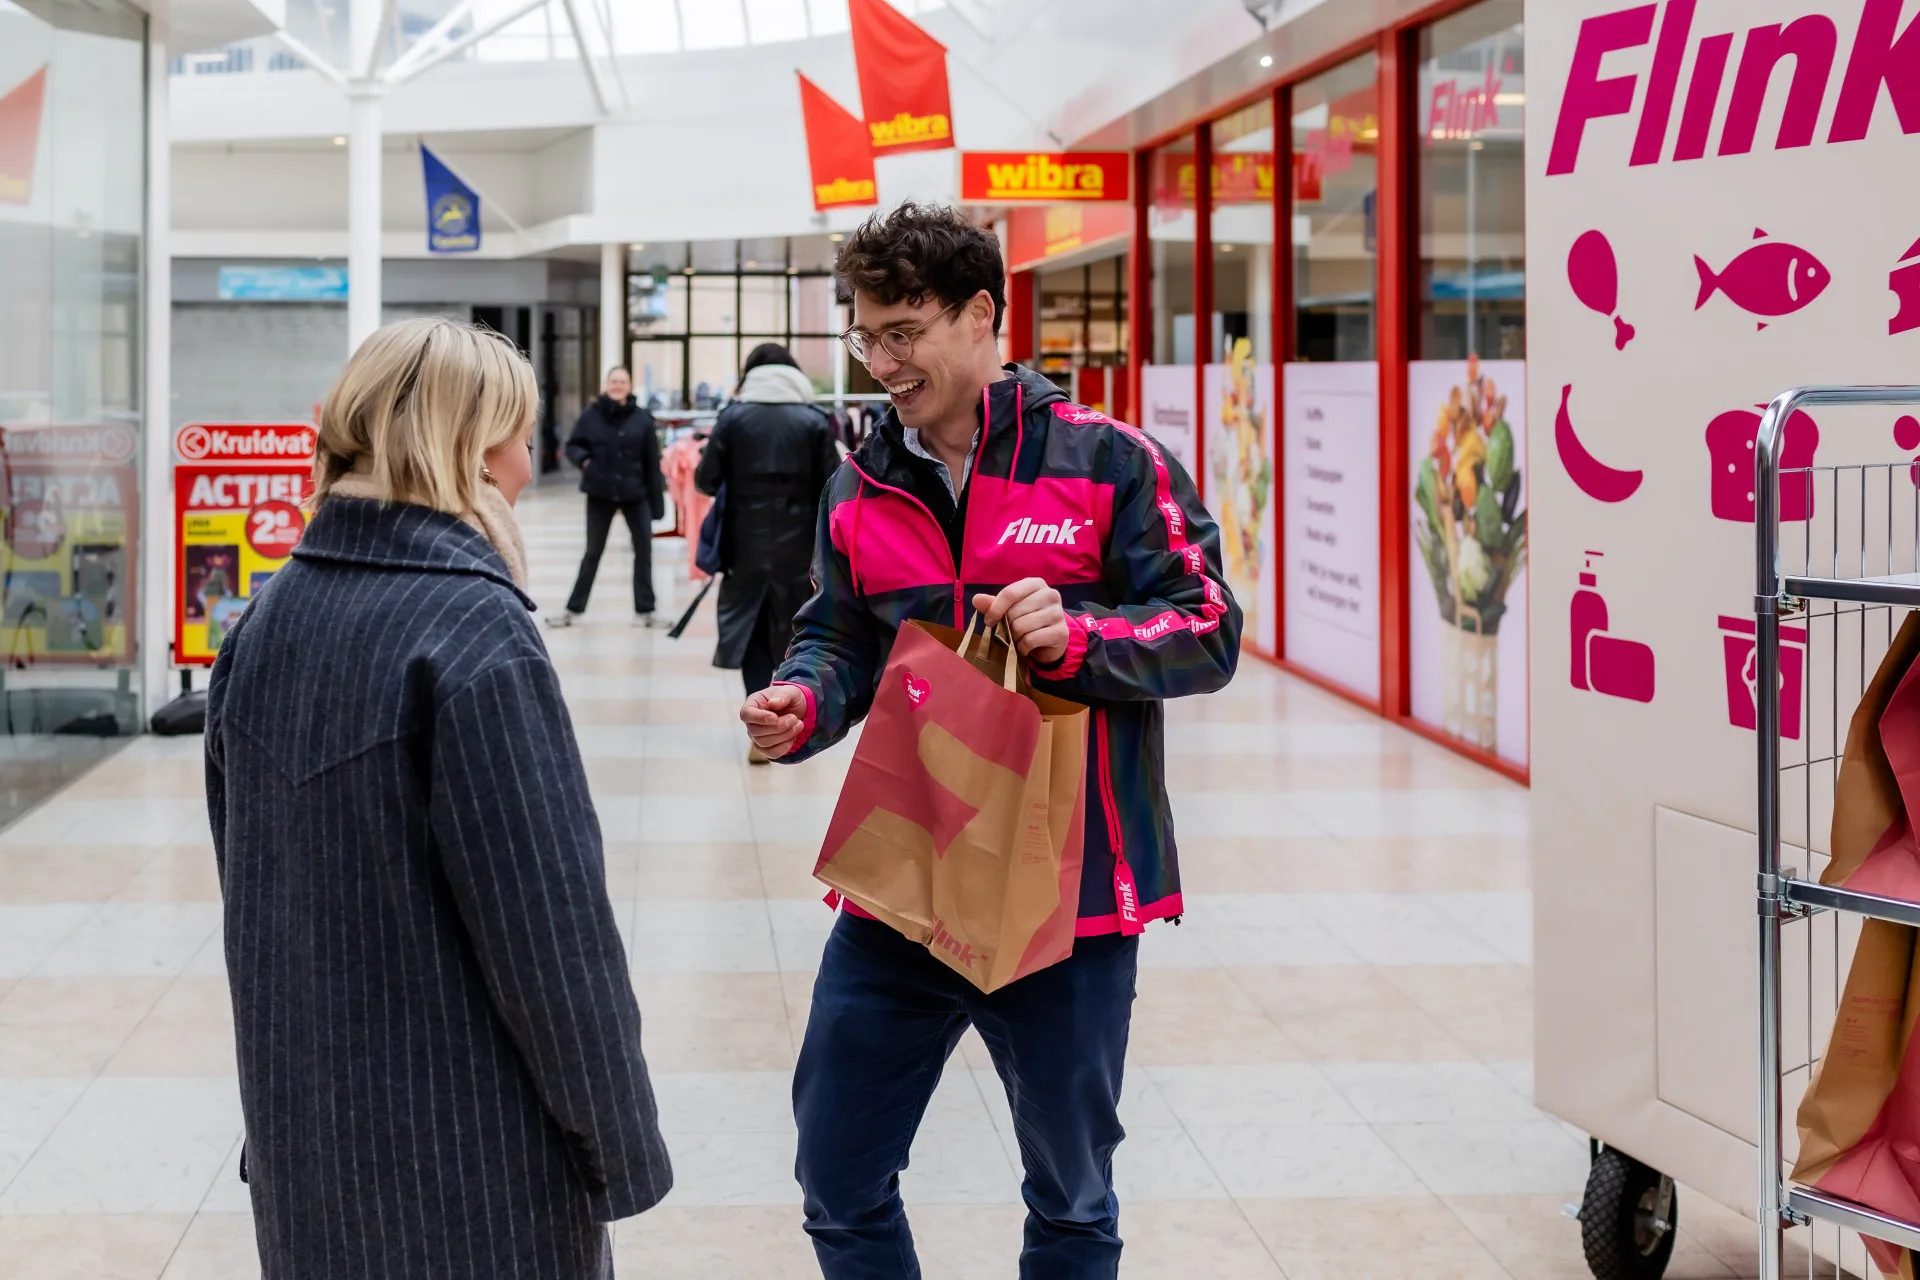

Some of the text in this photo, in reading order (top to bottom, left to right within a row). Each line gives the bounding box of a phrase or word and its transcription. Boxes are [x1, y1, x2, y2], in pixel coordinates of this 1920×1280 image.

[1546, 0, 1920, 177] Flink
[868, 112, 949, 142] wibra
[815, 177, 875, 201] wibra
[986, 155, 1104, 190] wibra
[211, 428, 313, 455] Kruidvat
[188, 474, 302, 507] ACTIE!
[997, 517, 1083, 545] Flink
[1161, 501, 1182, 536] Flink
[1134, 617, 1170, 639] Flink
[1118, 880, 1138, 922] Flink
[933, 914, 978, 970] link
